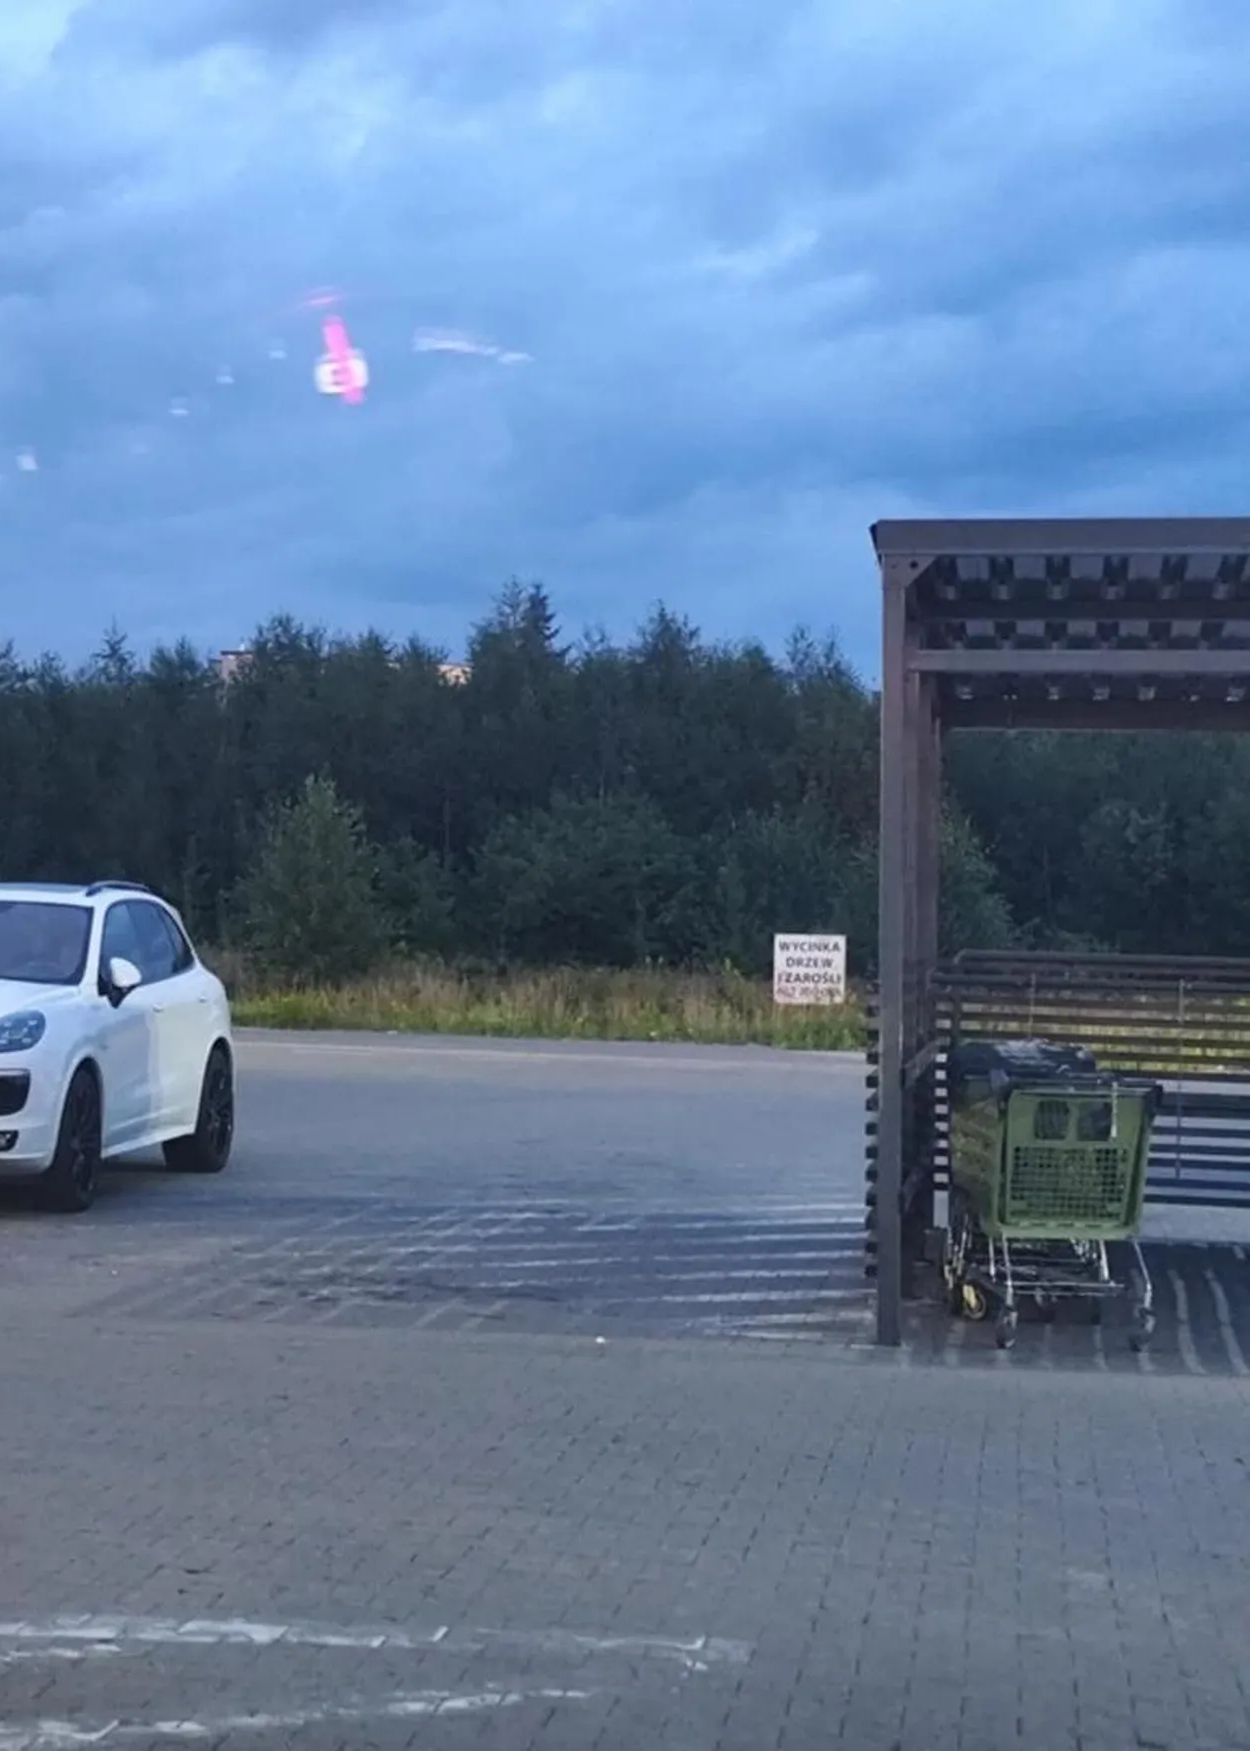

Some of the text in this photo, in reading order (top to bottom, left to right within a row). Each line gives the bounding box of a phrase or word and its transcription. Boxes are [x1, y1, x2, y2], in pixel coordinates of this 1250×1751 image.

[778, 941, 841, 952] WYCINKA
[785, 956, 834, 968] DRZEW
[785, 971, 842, 984] ZAROŚLI
